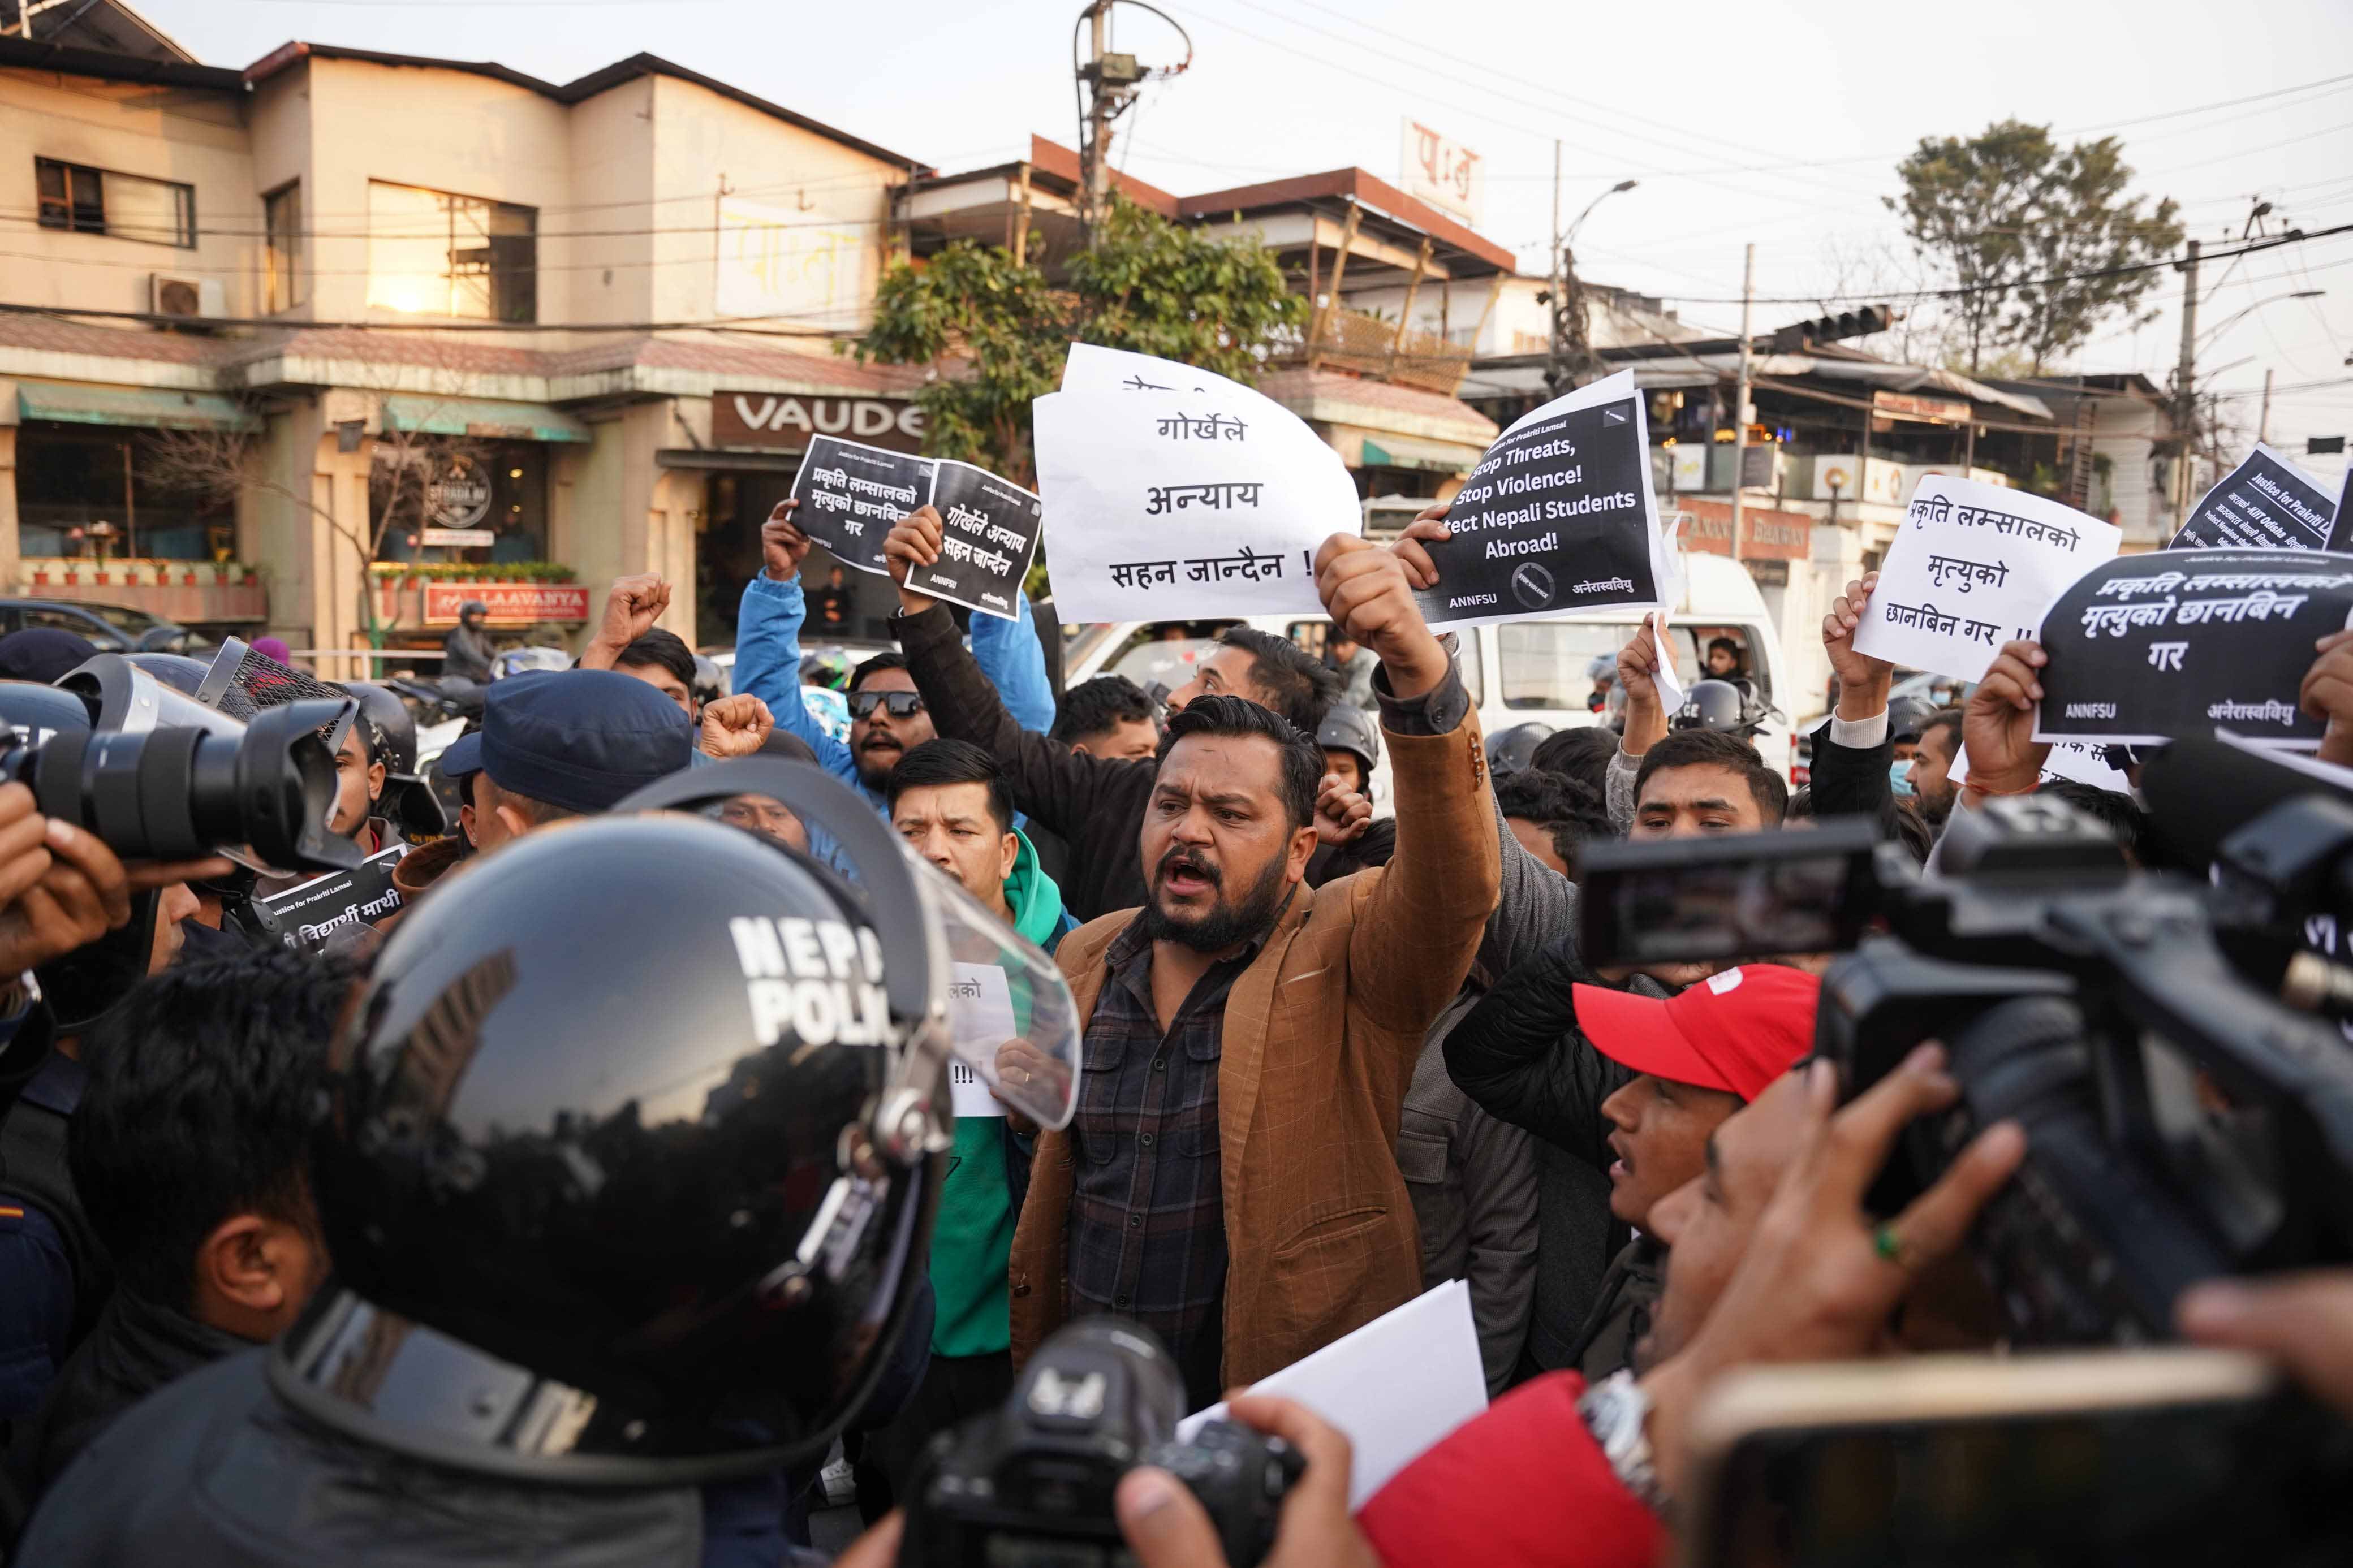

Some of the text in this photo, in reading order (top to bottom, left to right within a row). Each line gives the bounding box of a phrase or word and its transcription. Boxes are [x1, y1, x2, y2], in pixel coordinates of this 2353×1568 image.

[734, 396, 928, 437] VAUDE
[1157, 412, 1248, 440] गोर्खेले
[1506, 437, 1516, 446] for
[1516, 427, 1540, 441] Prakriti
[1541, 420, 1567, 434] Lamsal
[1506, 439, 1576, 466] Threats,
[812, 467, 917, 504] प्रकृति लम्सालको
[1145, 483, 1264, 515] अन्याय
[1456, 465, 1583, 505] Stop Violence!
[812, 489, 852, 512] मृत्युको
[1443, 490, 1636, 534] tect Nepali Students
[2251, 473, 2280, 498] Justice
[2277, 491, 2294, 507] for
[2290, 500, 2325, 528] Prakriti
[844, 520, 864, 537] गर
[1909, 494, 2081, 552] प्रकृति लम्सालको
[2204, 510, 2221, 526] Protect
[2260, 514, 2287, 539] Odisha
[986, 524, 1027, 553] अन्याय
[1485, 532, 1559, 560] Abroad!
[944, 535, 1012, 576] सहन जान्दैन
[1109, 561, 1176, 589] सहन
[1184, 546, 1285, 582] जान्दैन
[930, 574, 958, 589] ANNFSU
[1518, 573, 1549, 599] STOP VIOLENCE
[1928, 555, 2009, 593] मृत्युको
[2095, 571, 2187, 601] प्रकृति
[1449, 593, 1498, 610] ANNFSU
[2082, 590, 2309, 638] मृत्युको छानबिन
[1886, 602, 1960, 637] छानबिन
[1964, 619, 2001, 646] गर
[2148, 641, 2189, 672] गर
[2066, 703, 2117, 719] ANNFSU
[274, 905, 295, 915] ustice
[307, 889, 330, 904] Prakriti
[330, 880, 353, 895] Lamsal
